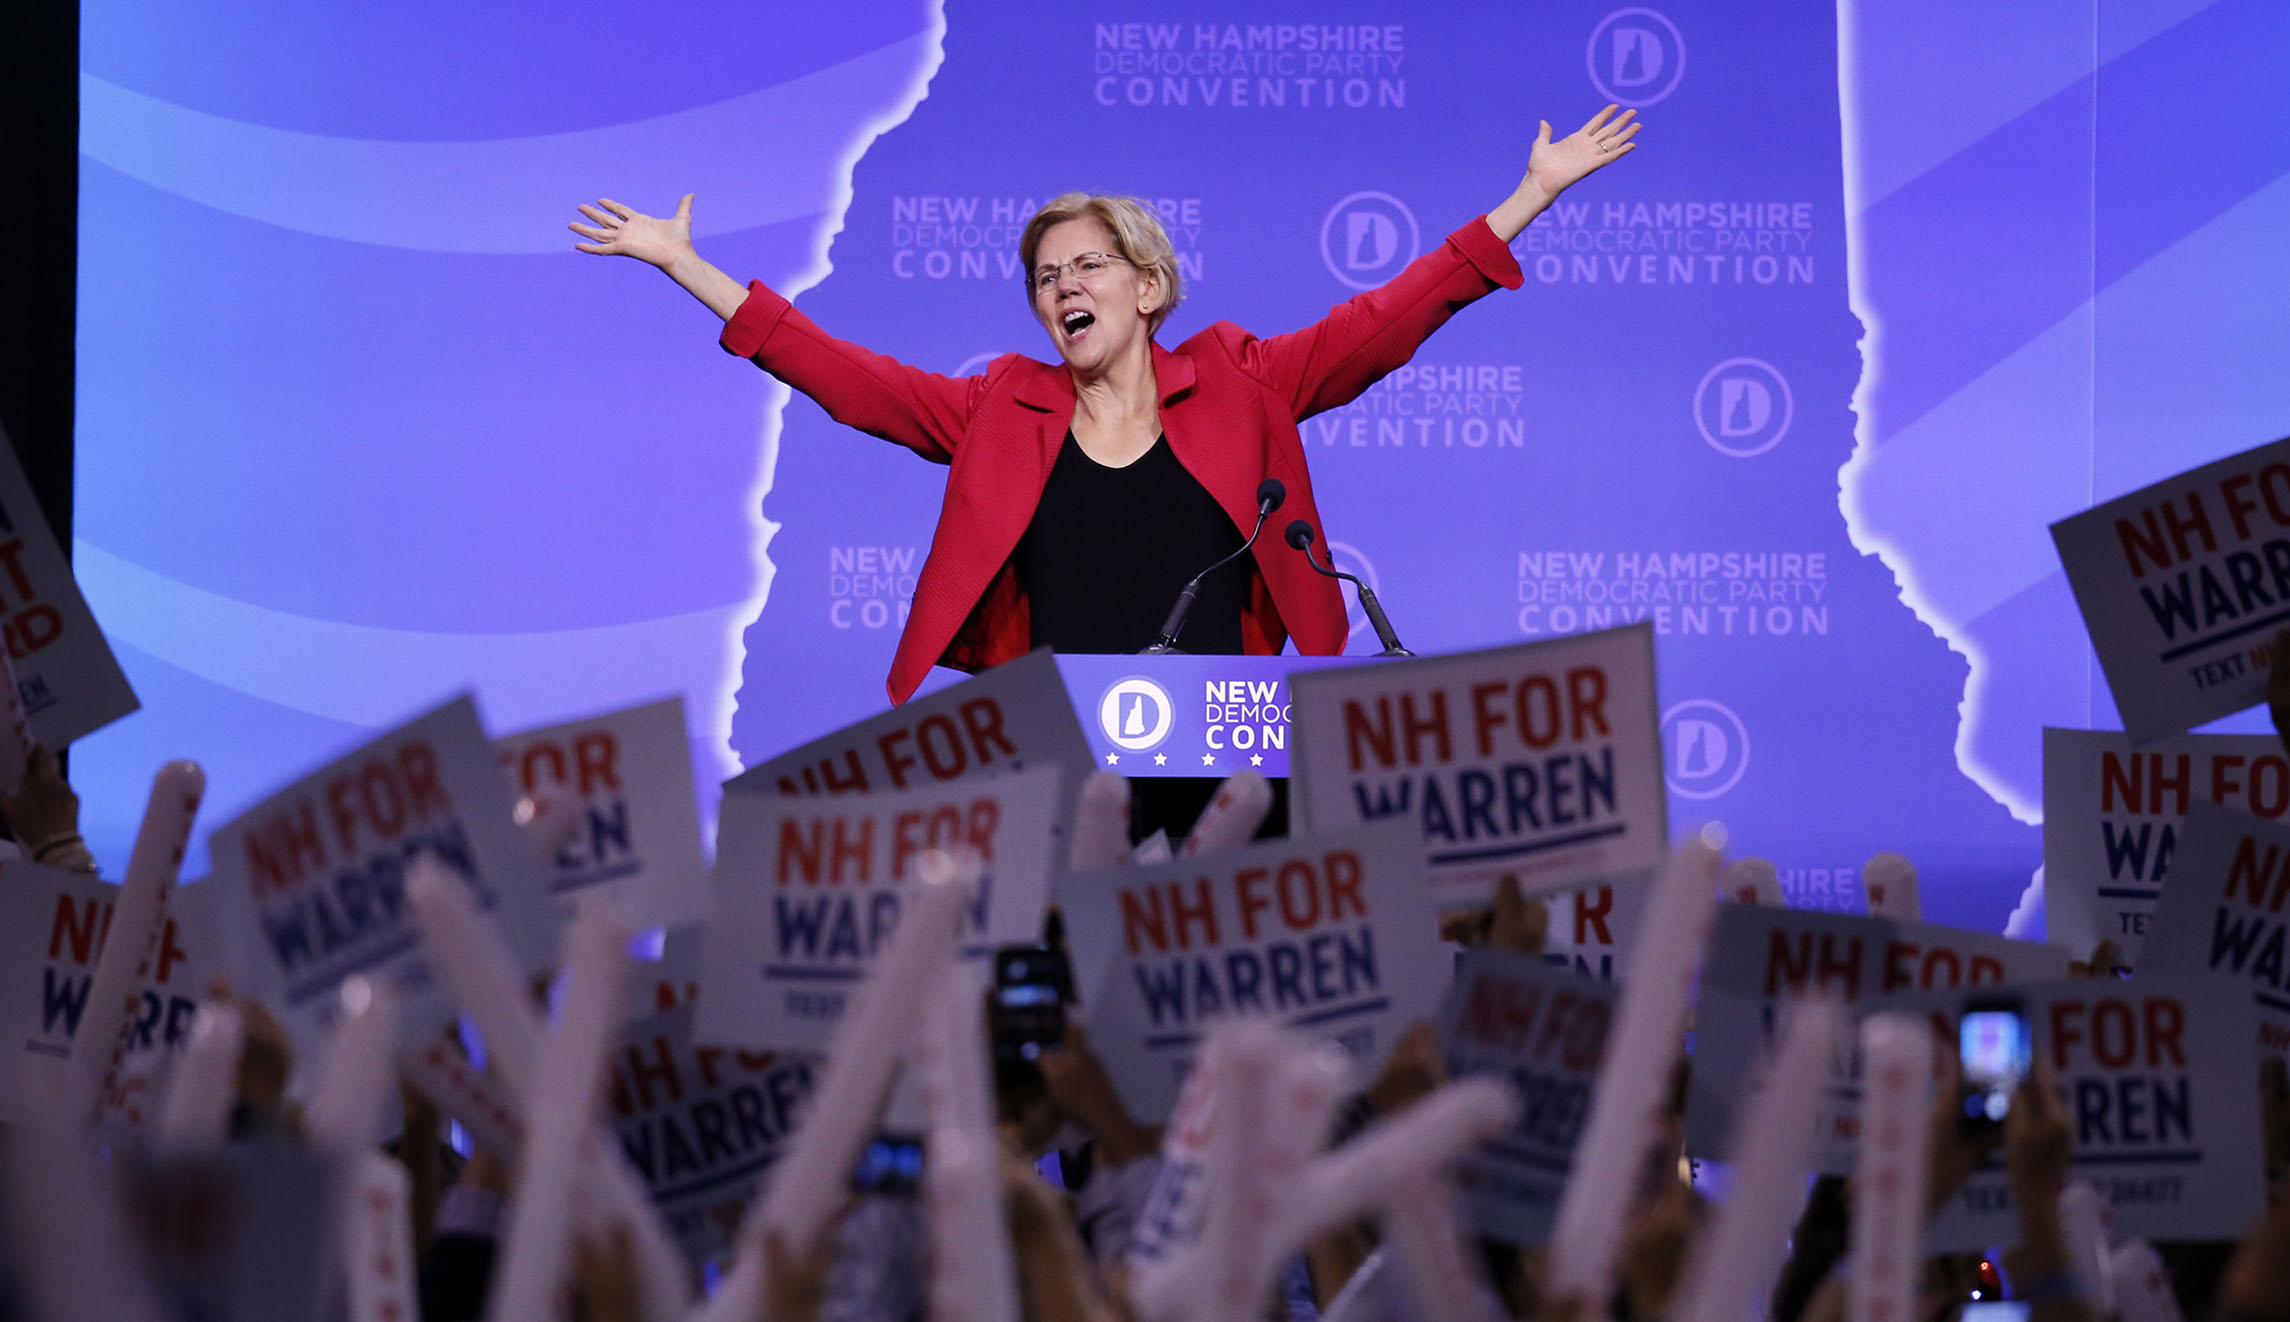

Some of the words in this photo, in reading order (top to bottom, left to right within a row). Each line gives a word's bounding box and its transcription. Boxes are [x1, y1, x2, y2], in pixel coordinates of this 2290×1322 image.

[1095, 24, 1182, 51] NEW
[1195, 24, 1405, 52] HAMPSHIRE
[1094, 51, 1295, 76] DEMOCRATIC
[1306, 53, 1405, 77] PARTY
[1095, 77, 1406, 108] CONVENTION
[893, 197, 978, 224] NEW
[1531, 202, 1592, 228] EW
[1602, 202, 1814, 230] HAMPSHIRE
[1716, 231, 1815, 254] PARTY
[1513, 253, 1816, 285] ONVENTION
[1425, 393, 1525, 417] PARTY
[2112, 490, 2219, 580] NH
[830, 546, 916, 574] NEW
[1517, 552, 1605, 579] NEW
[1617, 552, 1828, 580] HAMPSHIRE
[1517, 579, 1719, 604] DEMOCRATIC
[1729, 580, 1828, 604] PARTY
[1205, 680, 1279, 704] NEW
[1344, 689, 1452, 773] NH
[1472, 666, 1610, 758] FOR
[878, 697, 1016, 788] FOR
[1355, 745, 1618, 842] WARREN
[2101, 751, 2190, 817] NH
[243, 795, 330, 902] NH
[325, 741, 450, 858] FOR
[774, 816, 874, 887] NH
[1119, 877, 1220, 956] NH
[1236, 849, 1367, 943] FOR
[1134, 924, 1379, 1028] WARREN
[1764, 927, 1863, 1004] NH
[2050, 998, 2188, 1071] FOR
